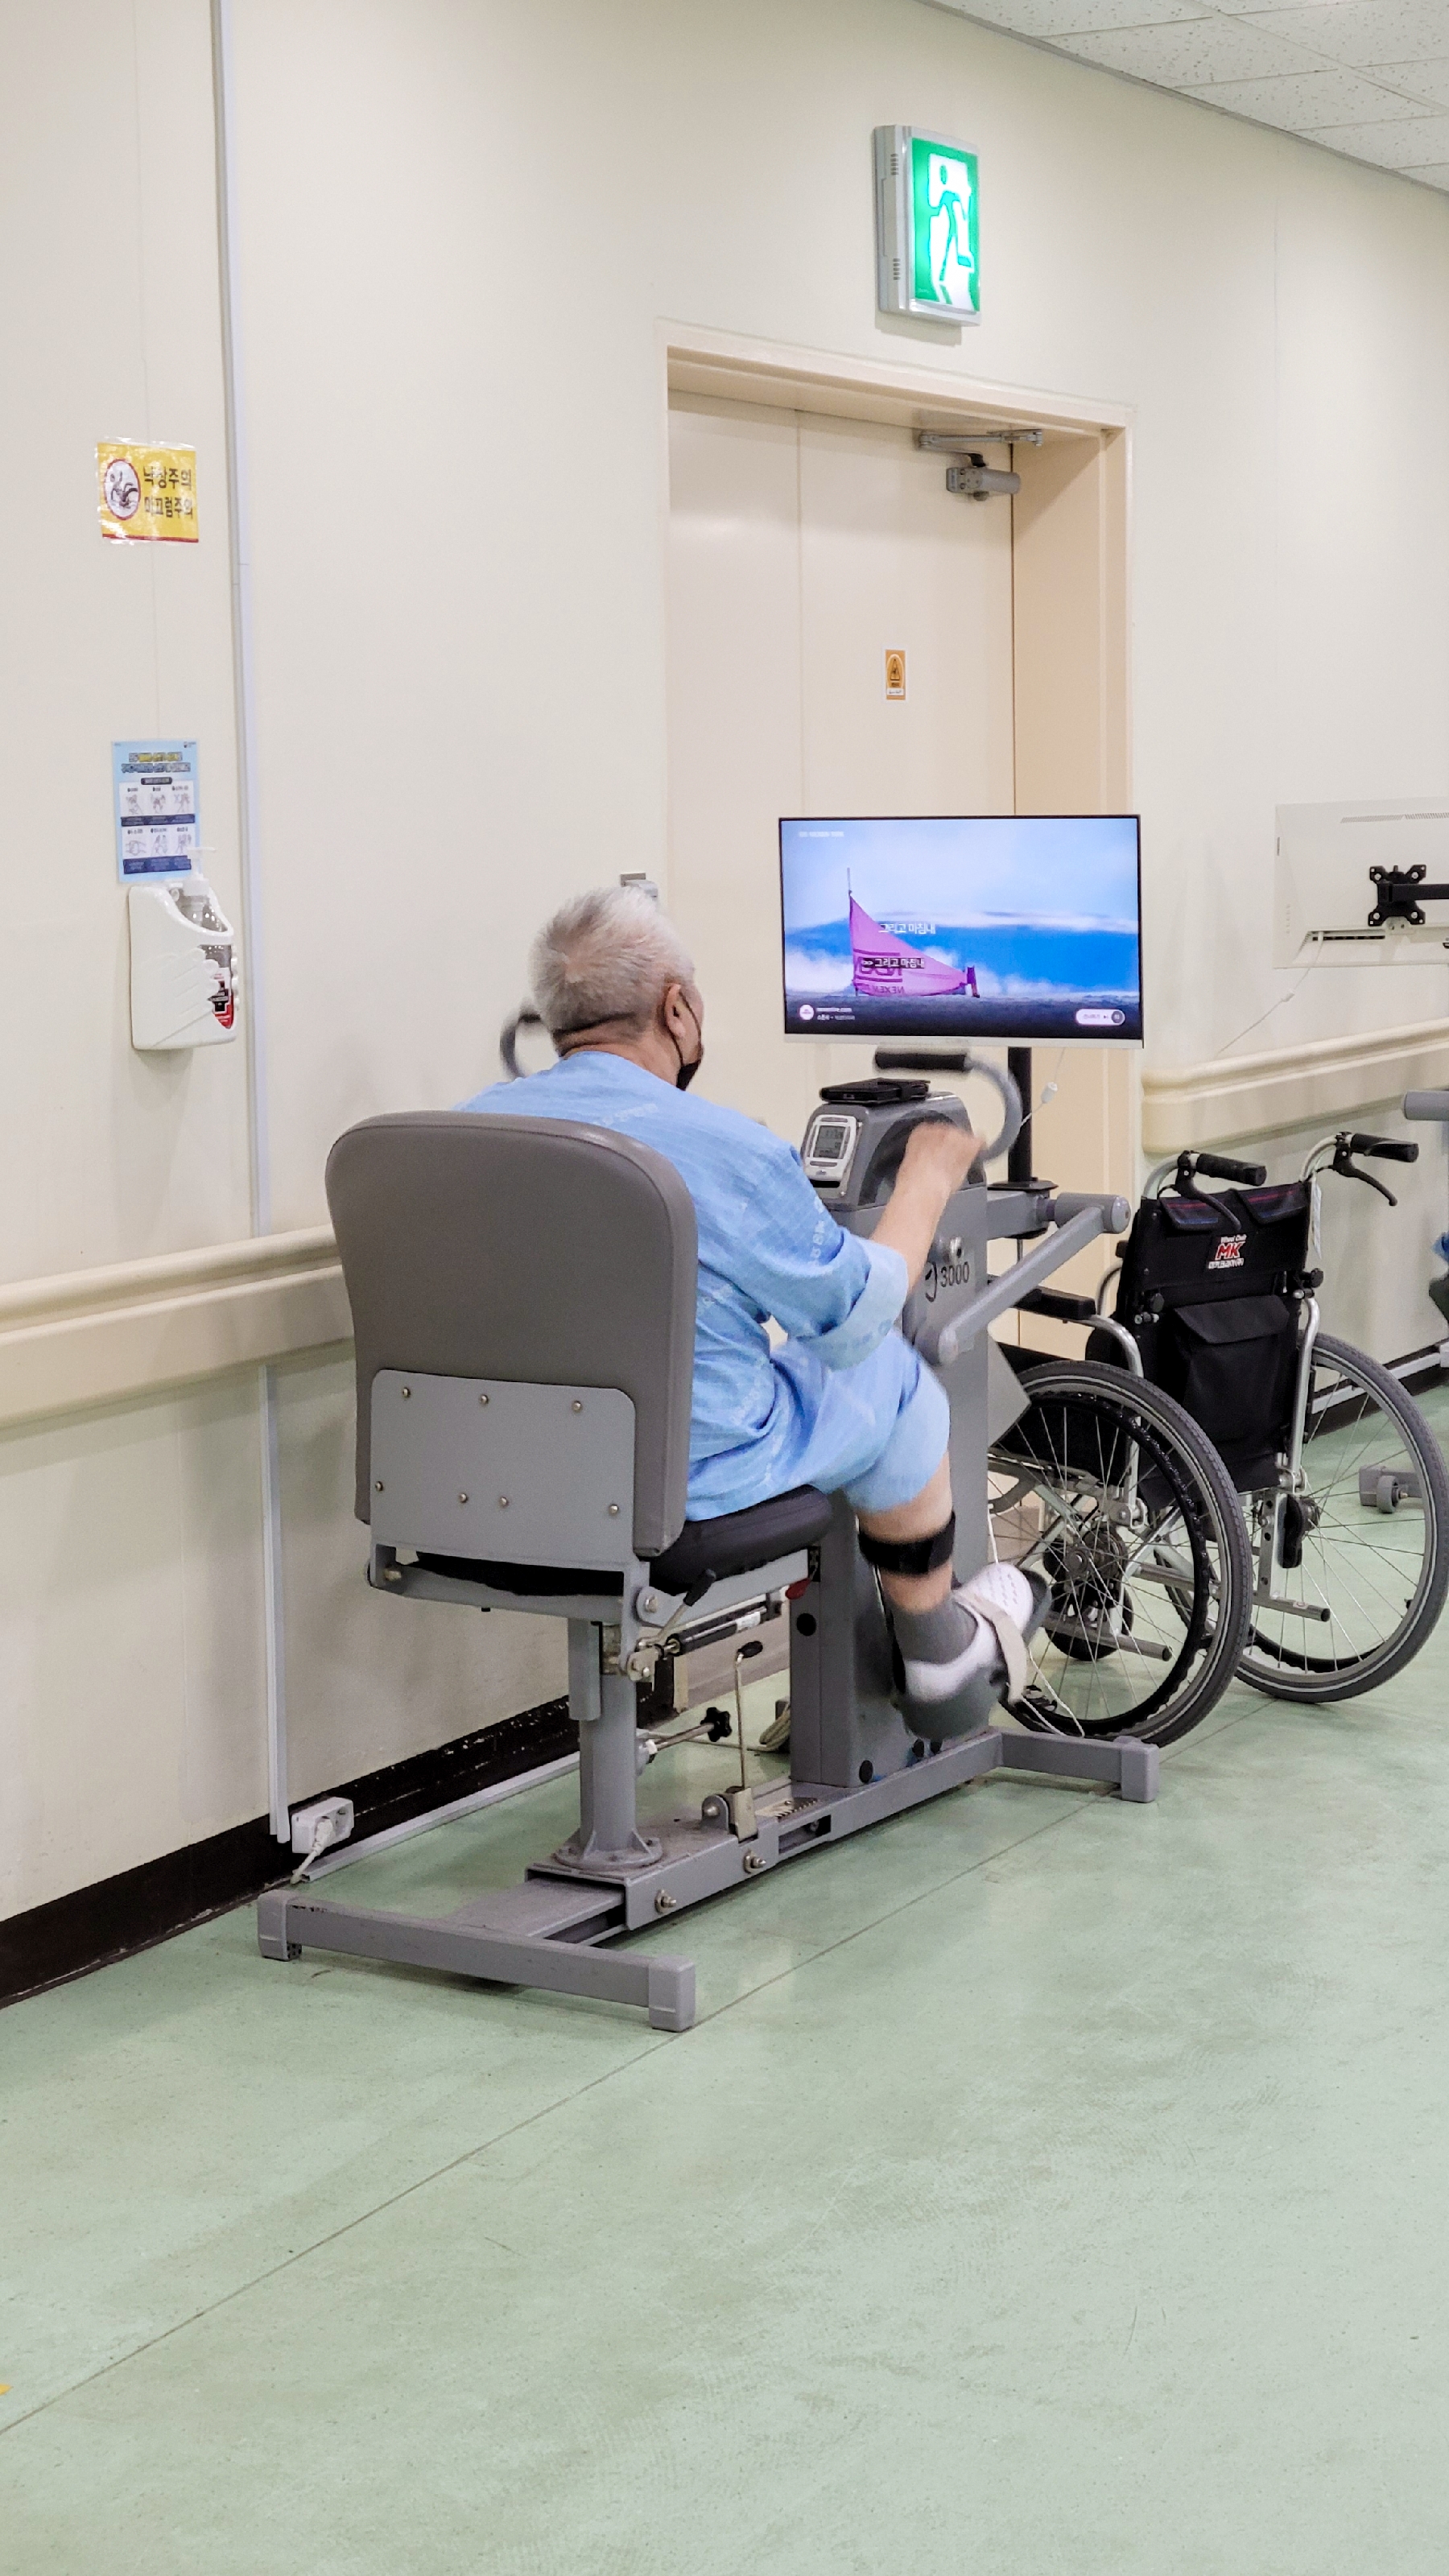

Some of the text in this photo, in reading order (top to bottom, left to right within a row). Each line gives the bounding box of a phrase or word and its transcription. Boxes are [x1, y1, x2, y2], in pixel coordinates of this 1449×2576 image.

[143, 465, 192, 490] 낙상주의
[879, 923, 936, 935] 그리고 마침내
[874, 958, 899, 968] 그리고
[1215, 1241, 1245, 1261] MK
[940, 1261, 970, 1288] 3000
